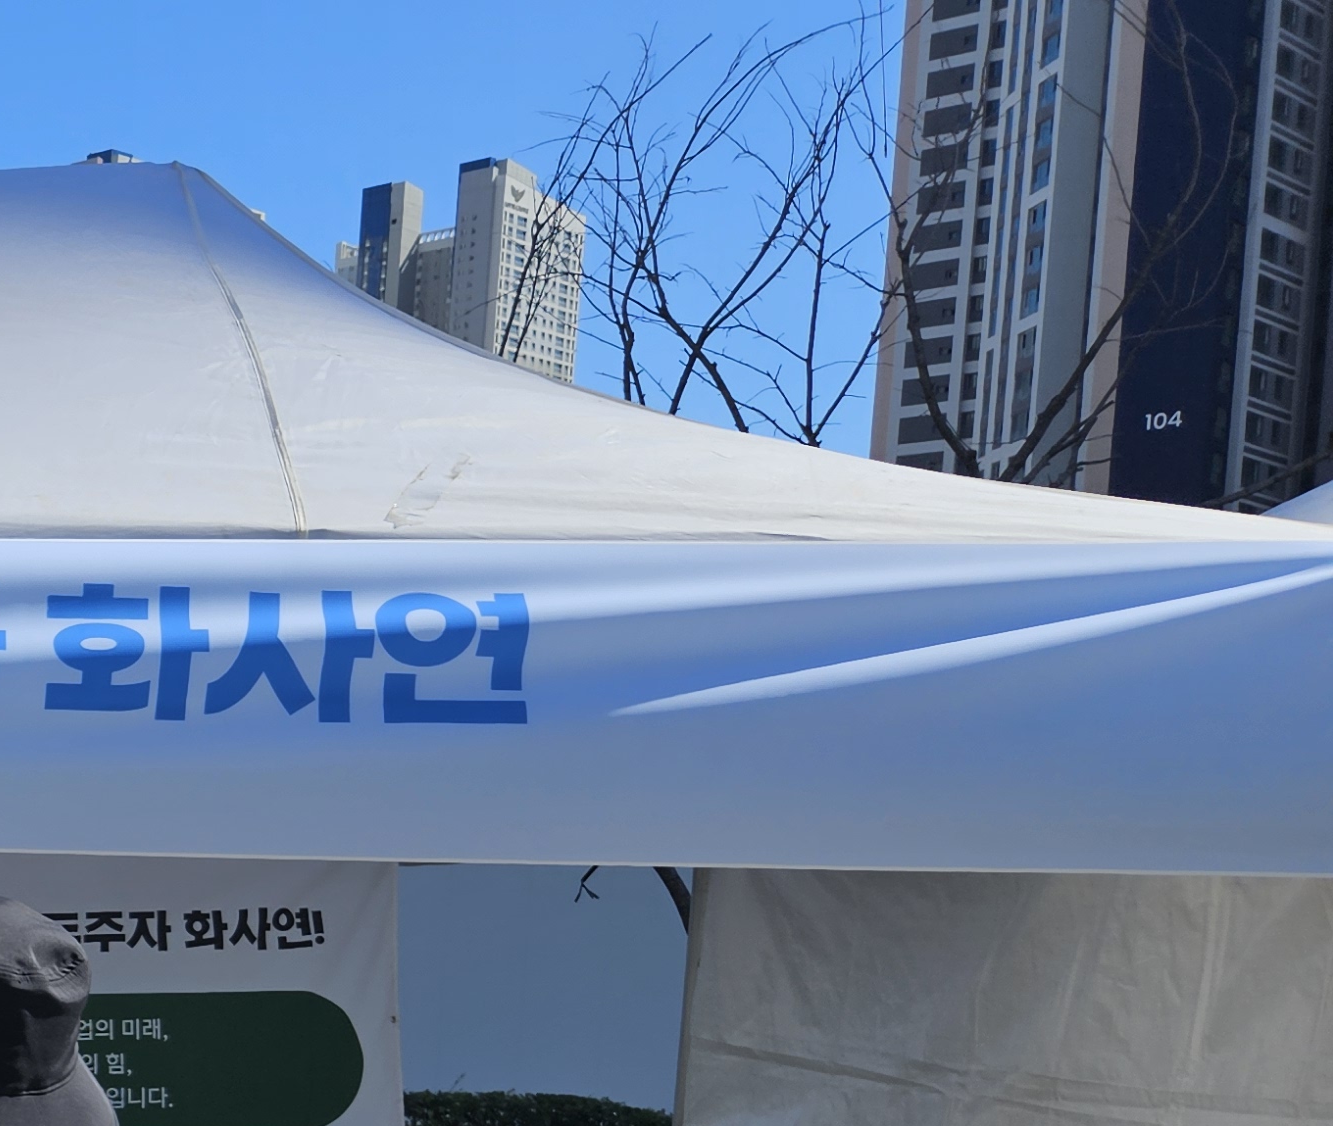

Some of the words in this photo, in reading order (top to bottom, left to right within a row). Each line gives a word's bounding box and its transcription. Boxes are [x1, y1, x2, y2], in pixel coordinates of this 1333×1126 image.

[1145, 410, 1182, 430] 104
[44, 583, 531, 726] 화사연
[183, 907, 326, 951] 화사연!
[122, 1017, 169, 1042] 미래,
[106, 1052, 133, 1076] 힘,
